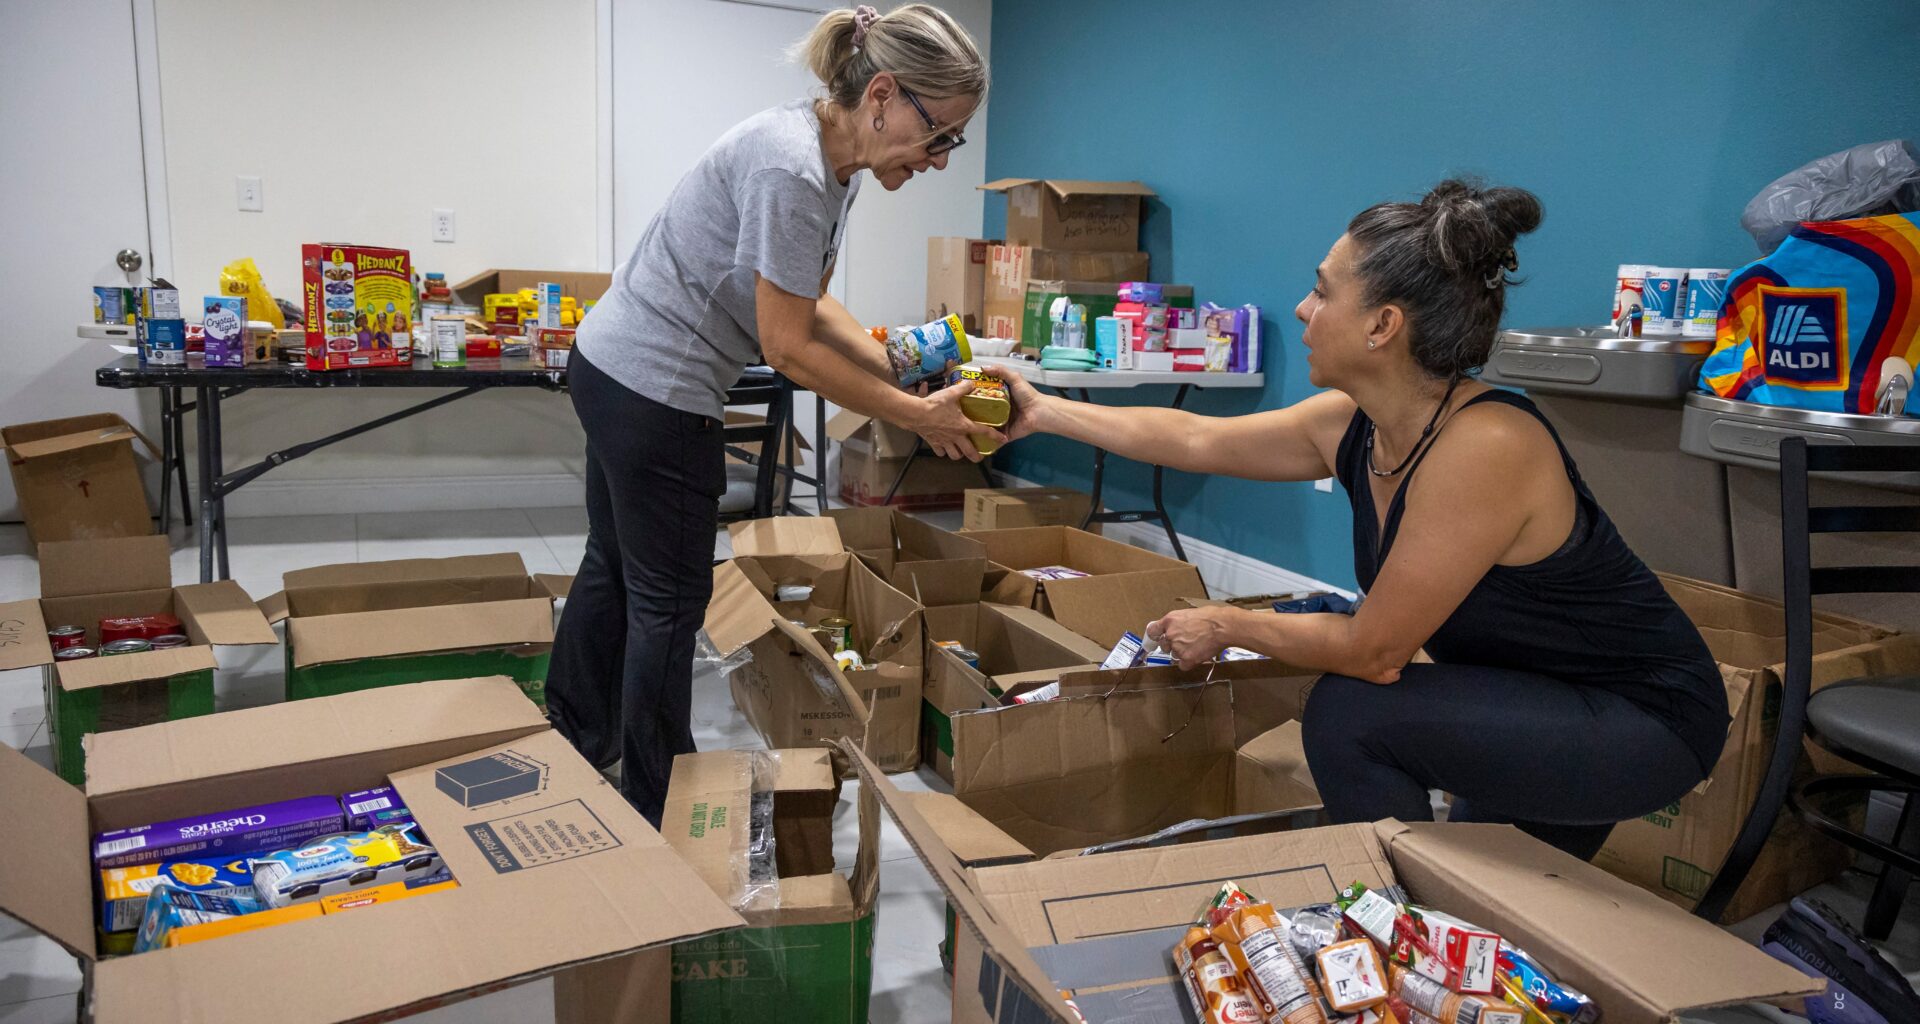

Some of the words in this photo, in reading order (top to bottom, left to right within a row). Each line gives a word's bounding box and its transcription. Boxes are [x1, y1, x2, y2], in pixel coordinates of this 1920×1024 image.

[357, 253, 405, 273] HEDBANZ
[206, 316, 236, 332] Crystal
[219, 320, 239, 334] light
[1769, 349, 1830, 370] ALDI
[1739, 436, 1780, 449] ELK
[179, 814, 266, 834] Cheerios
[710, 806, 727, 829] FRAGILE
[211, 826, 234, 836] Multi
[295, 855, 352, 873] PINEAPPLE
[671, 958, 749, 981] CAKE
